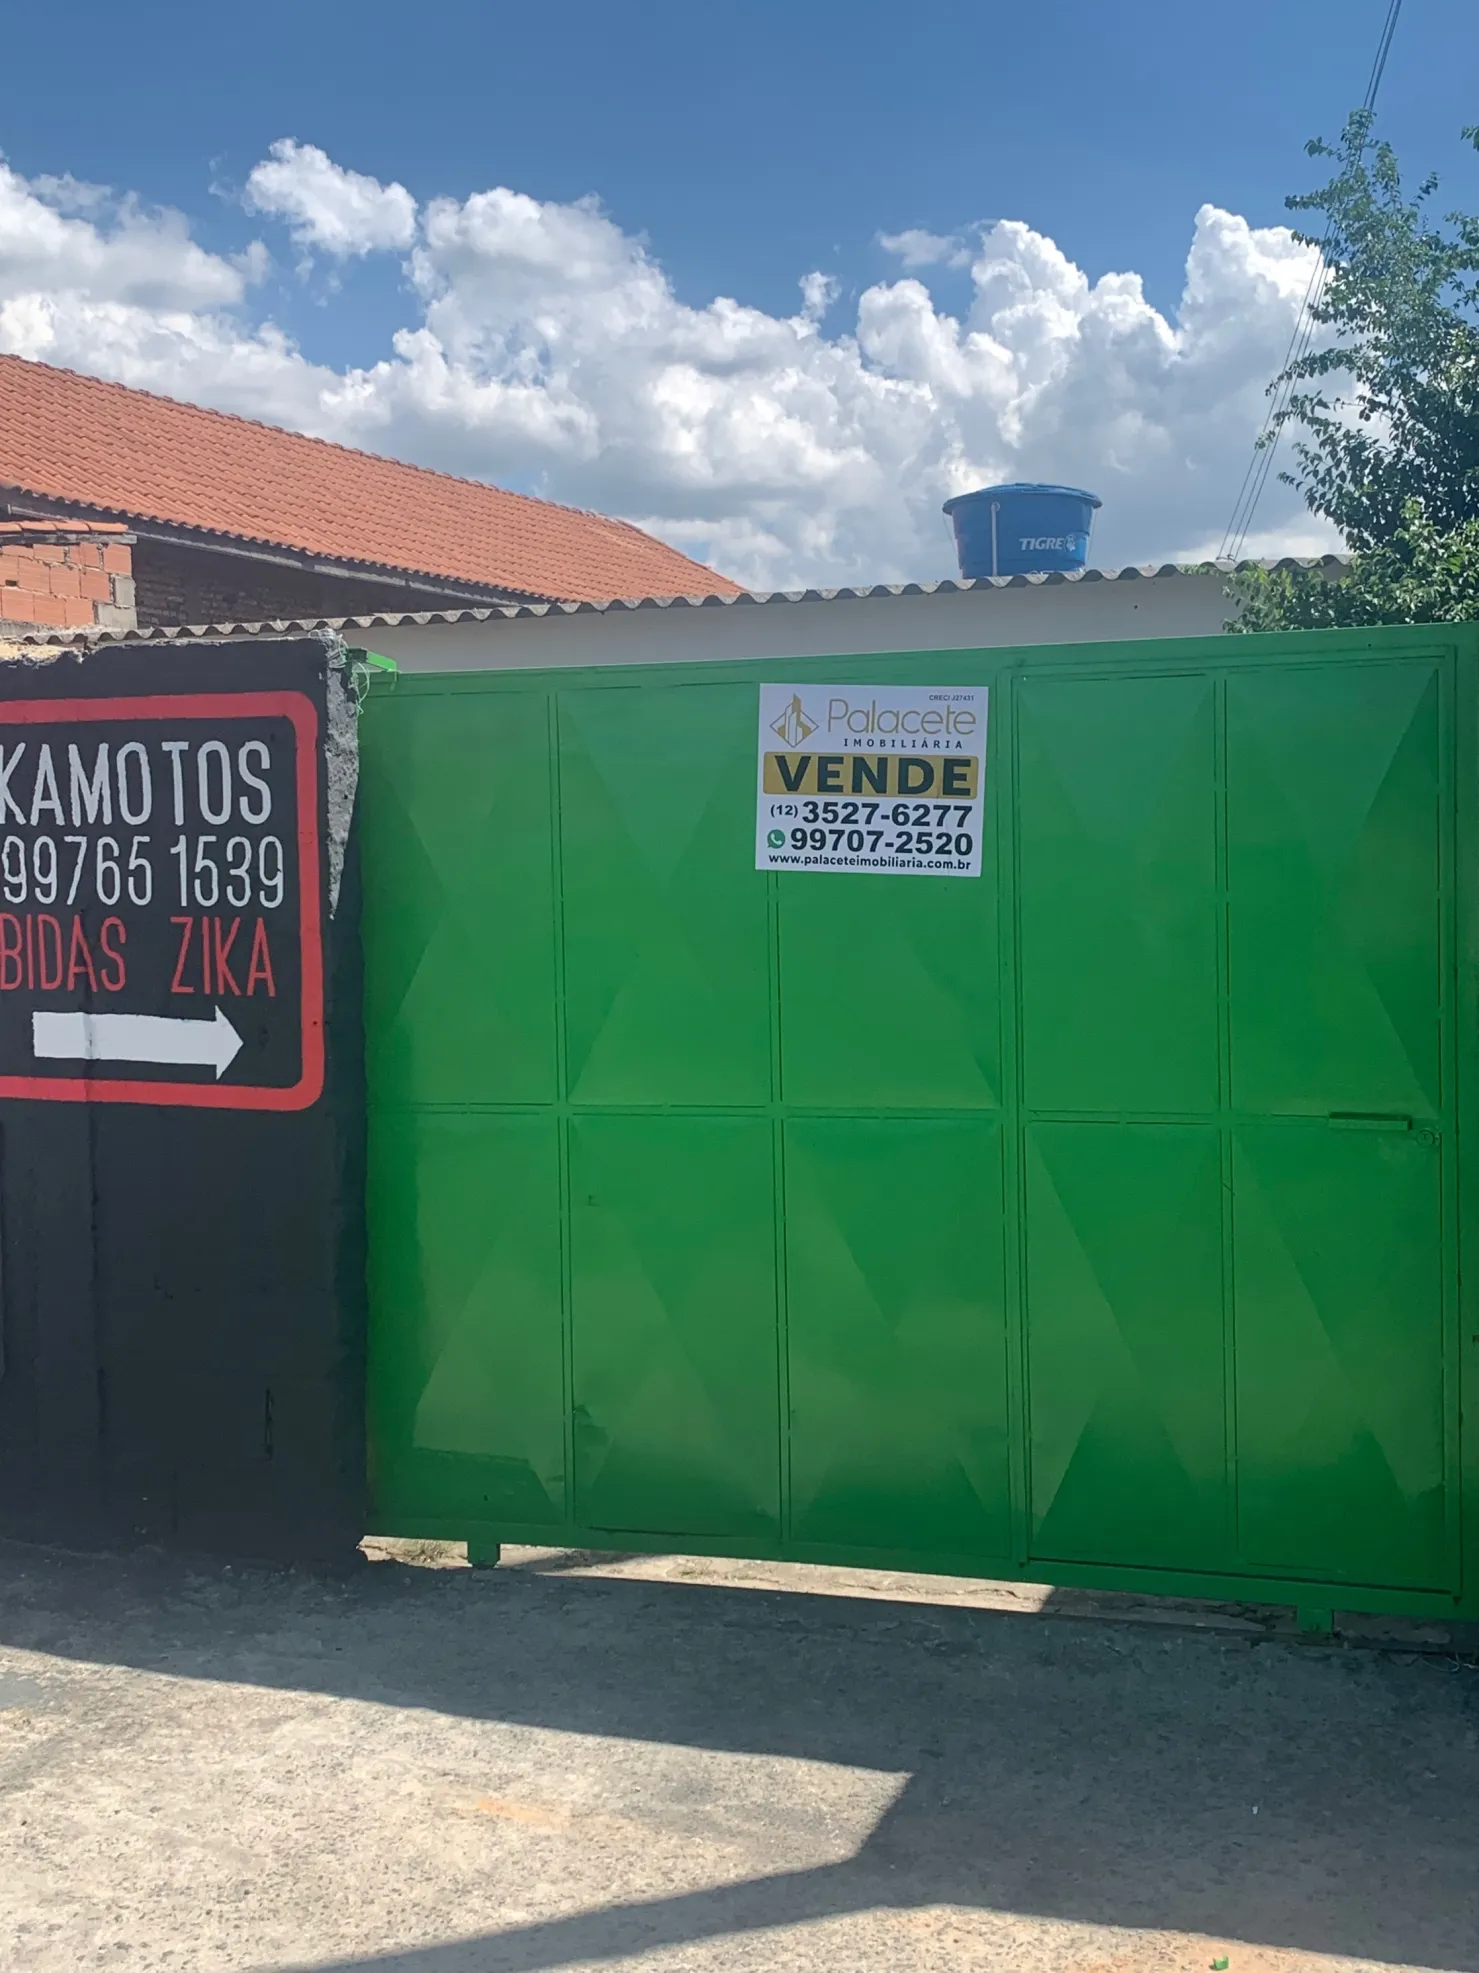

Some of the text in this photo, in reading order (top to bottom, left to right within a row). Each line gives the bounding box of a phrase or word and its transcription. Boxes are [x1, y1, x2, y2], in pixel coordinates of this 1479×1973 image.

[1019, 537, 1065, 551] TIGRE
[827, 698, 977, 736] Palacete
[843, 736, 963, 750] IMOBILIÁRIA
[774, 755, 972, 796] VENDE
[770, 800, 973, 828] (12) 3527-6277
[790, 828, 973, 856] 99707-2520
[2, 835, 284, 909] 99765 1539
[768, 854, 972, 871] www.palaceteimobiliaria.com.br
[0, 913, 276, 998] BIDAS ZIKA
